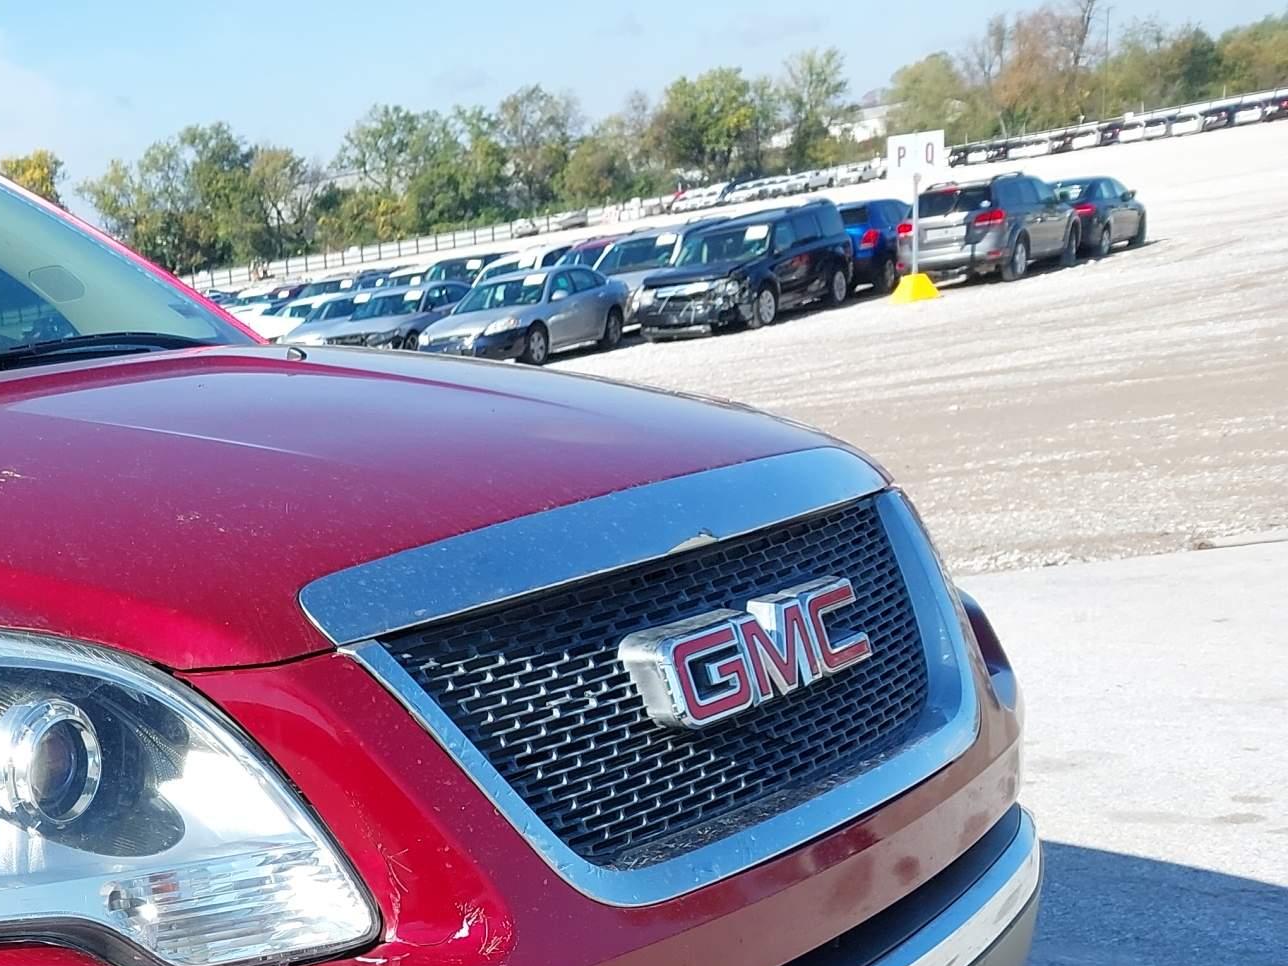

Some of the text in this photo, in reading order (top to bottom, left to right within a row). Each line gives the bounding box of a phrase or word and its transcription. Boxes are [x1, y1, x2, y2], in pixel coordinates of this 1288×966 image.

[897, 142, 935, 168] P Q
[656, 577, 873, 729] GMC
